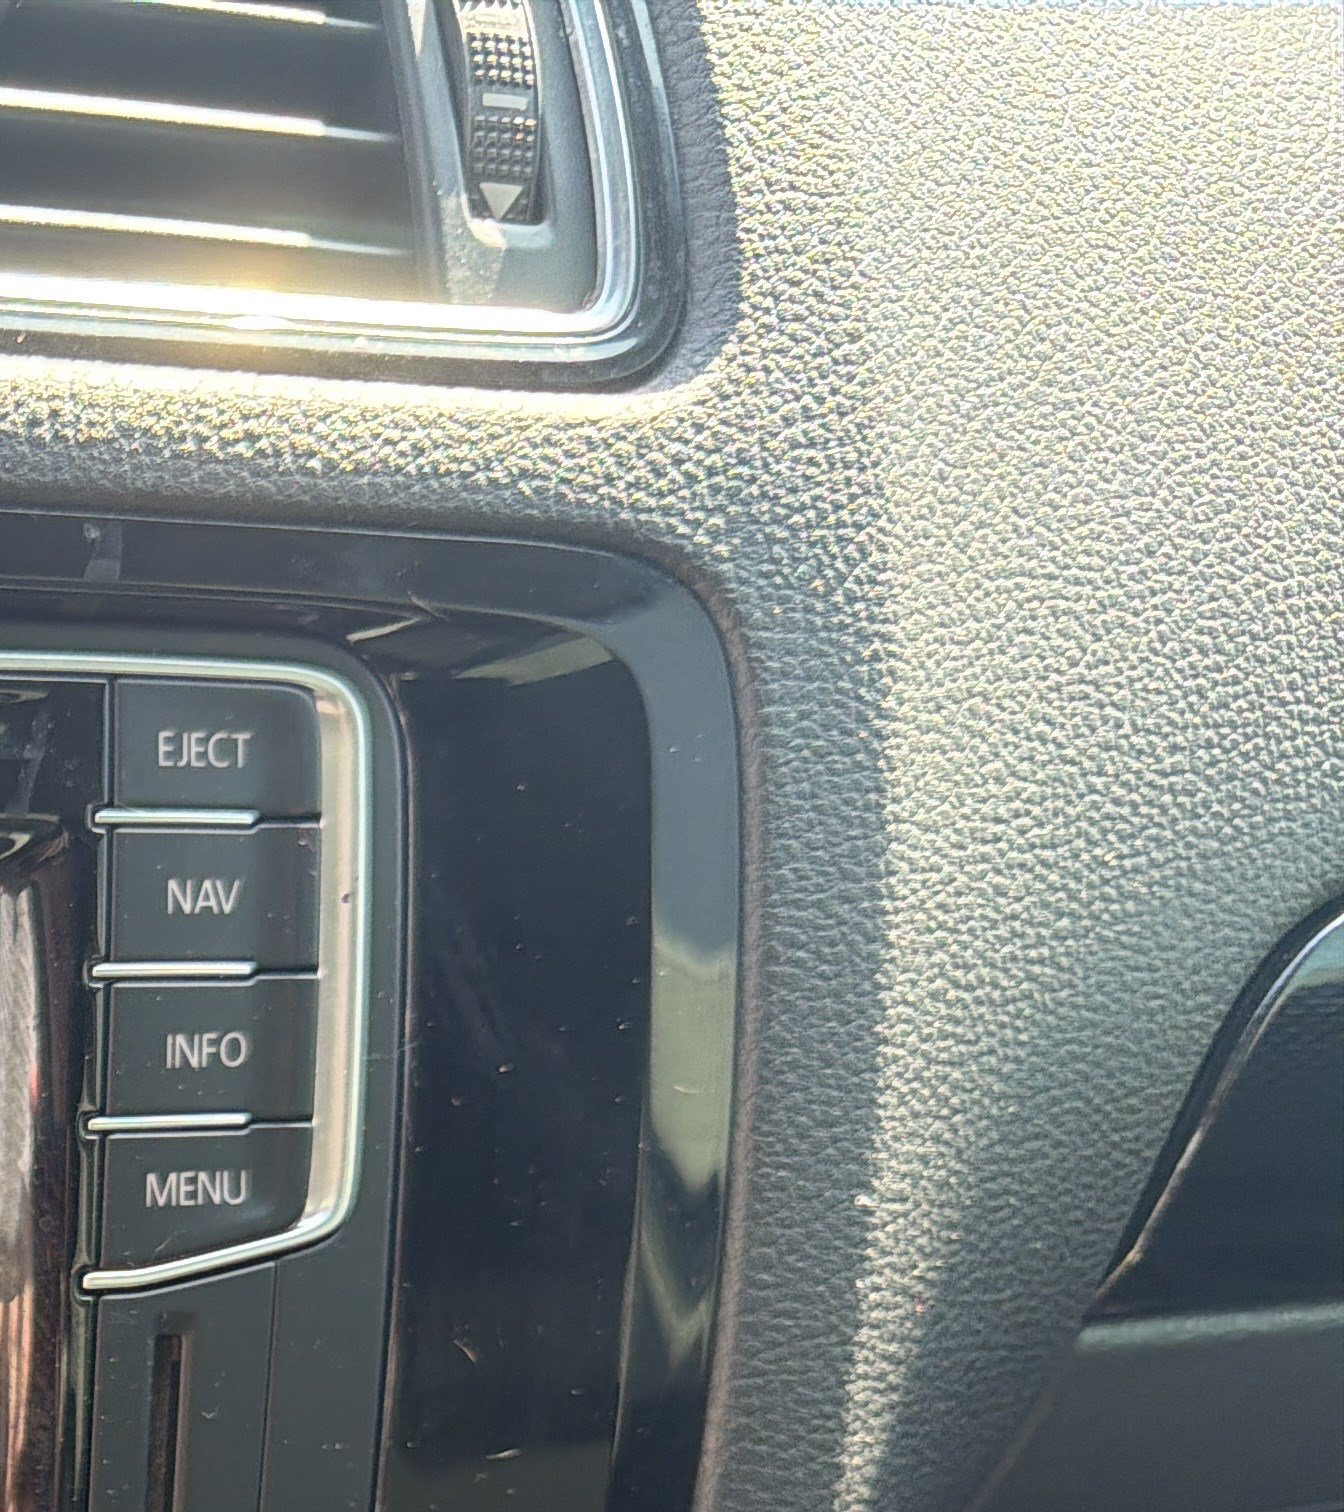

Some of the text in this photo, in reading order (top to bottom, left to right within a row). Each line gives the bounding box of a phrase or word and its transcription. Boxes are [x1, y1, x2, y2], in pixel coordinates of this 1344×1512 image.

[157, 730, 254, 768] EJECT
[166, 878, 241, 915] NAV
[165, 1031, 249, 1069] INFO
[145, 1170, 249, 1208] MENU
